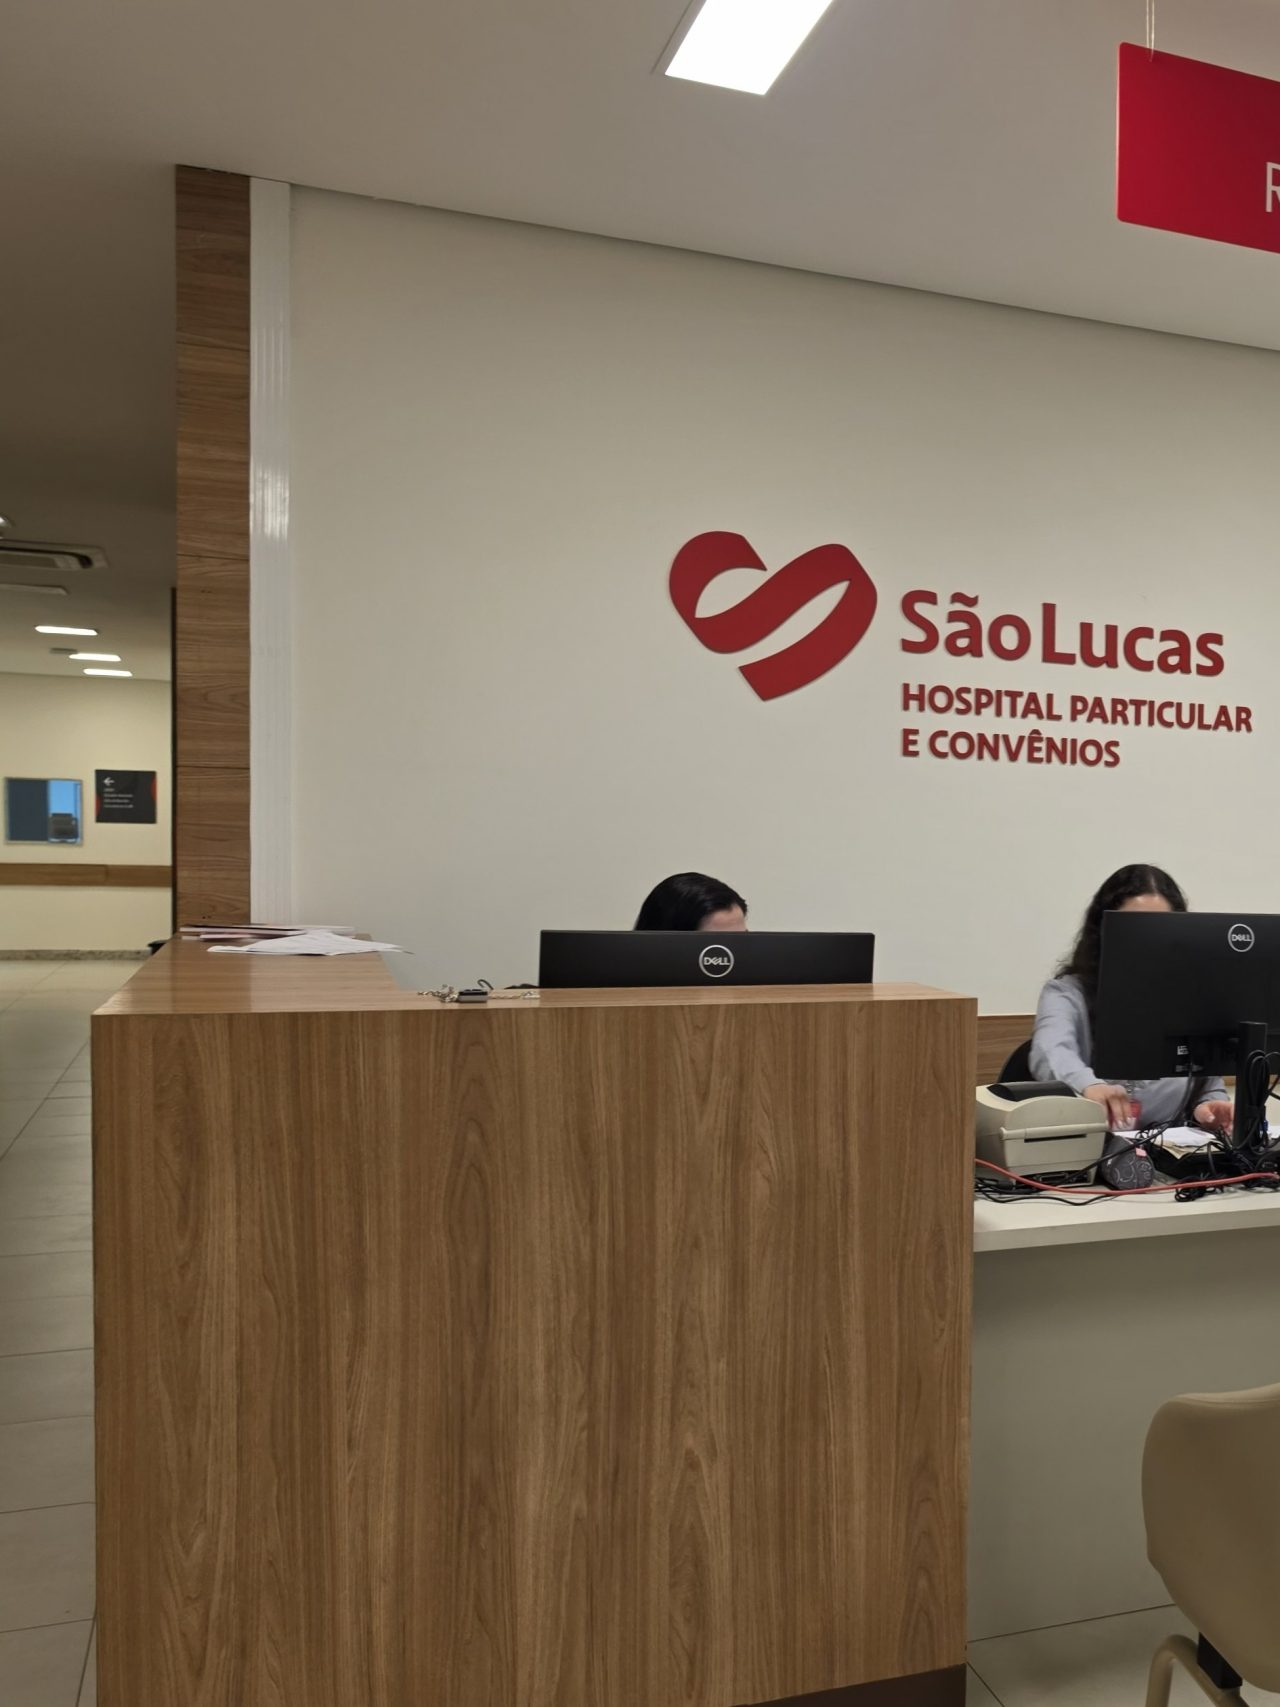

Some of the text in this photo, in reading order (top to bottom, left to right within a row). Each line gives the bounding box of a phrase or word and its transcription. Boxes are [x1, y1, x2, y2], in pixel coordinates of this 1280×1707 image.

[902, 682, 1253, 733] HOSPITAL PARTICULAR
[902, 728, 1120, 768] E CONVÊNIOS
[1231, 933, 1252, 942] DELL
[703, 956, 731, 966] DELL
